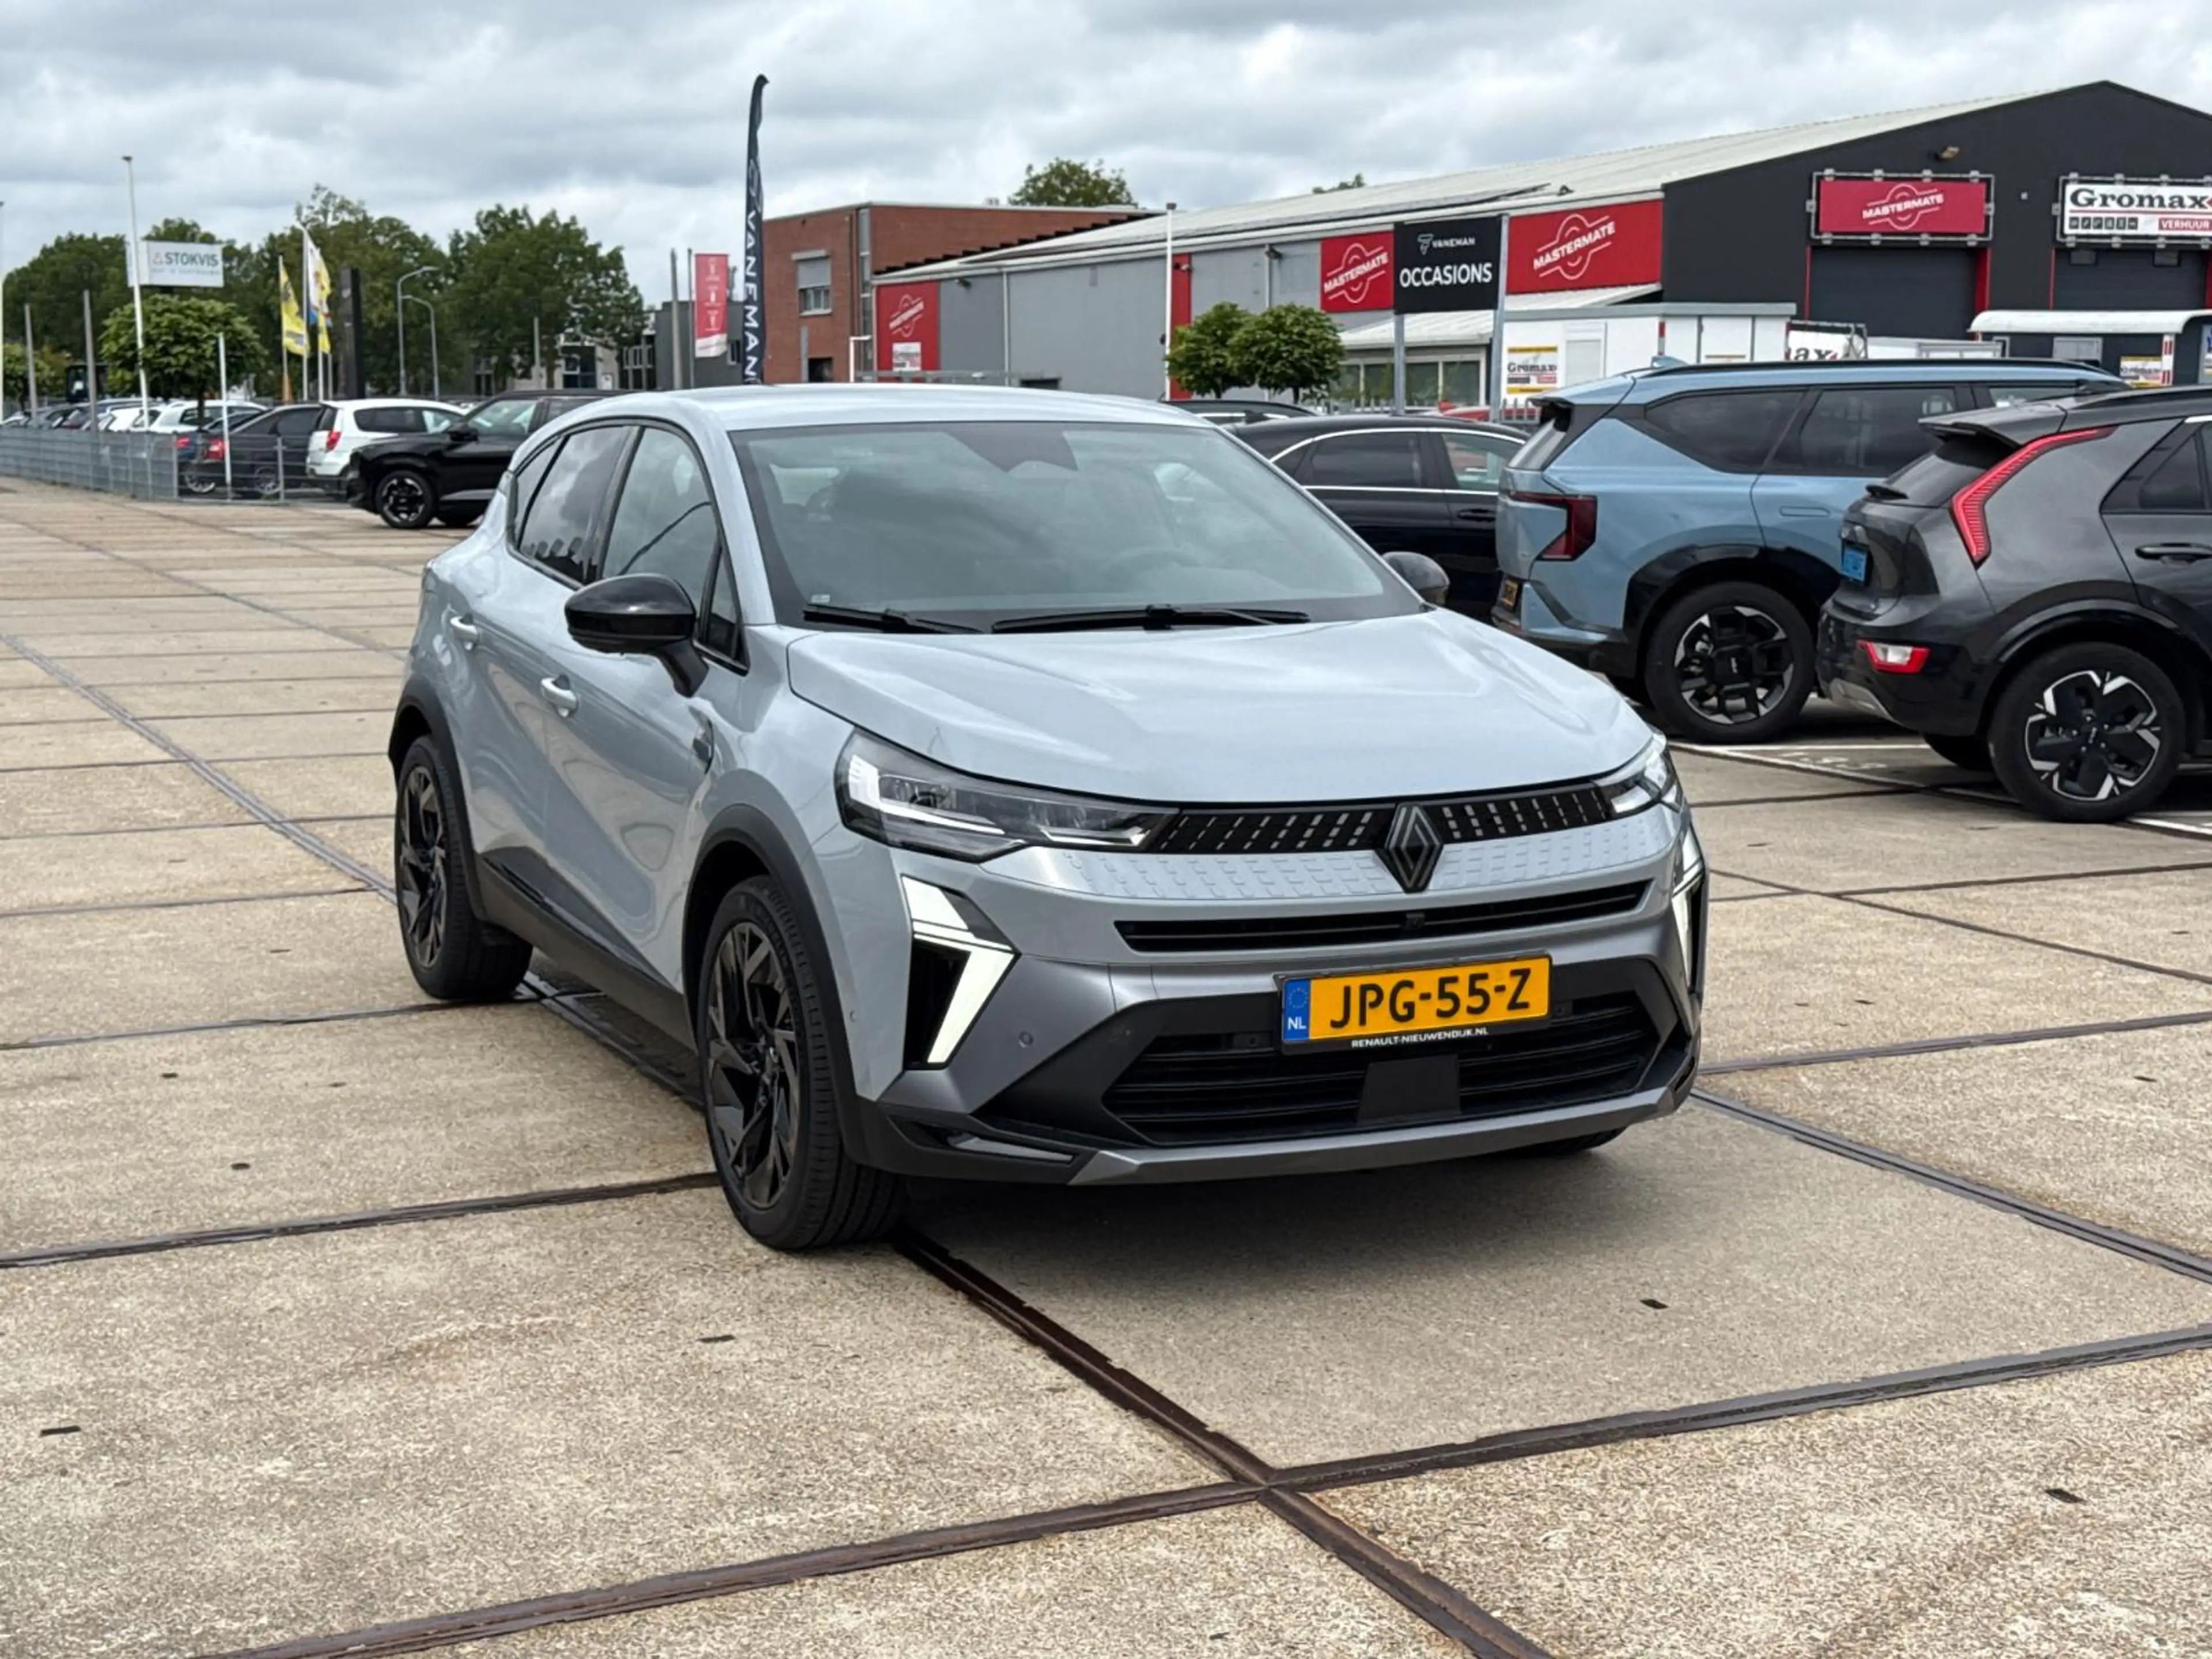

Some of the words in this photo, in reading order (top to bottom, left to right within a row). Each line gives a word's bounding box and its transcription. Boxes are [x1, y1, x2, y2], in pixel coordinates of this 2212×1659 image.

[1862, 194, 1944, 219] MASTERMATE
[2070, 188, 2209, 209] Gromax
[2161, 220, 2210, 230] VERHUUR
[1432, 237, 1475, 248] VANEMAN
[1533, 221, 1615, 270] MASTERMATE
[165, 252, 219, 267] STOKVIS
[1324, 252, 1389, 293] MASTERMATE
[1399, 263, 1493, 288] OCCASIONS
[1330, 968, 1531, 1029] JPG-55-Z
[1287, 1016, 1307, 1031] NL
